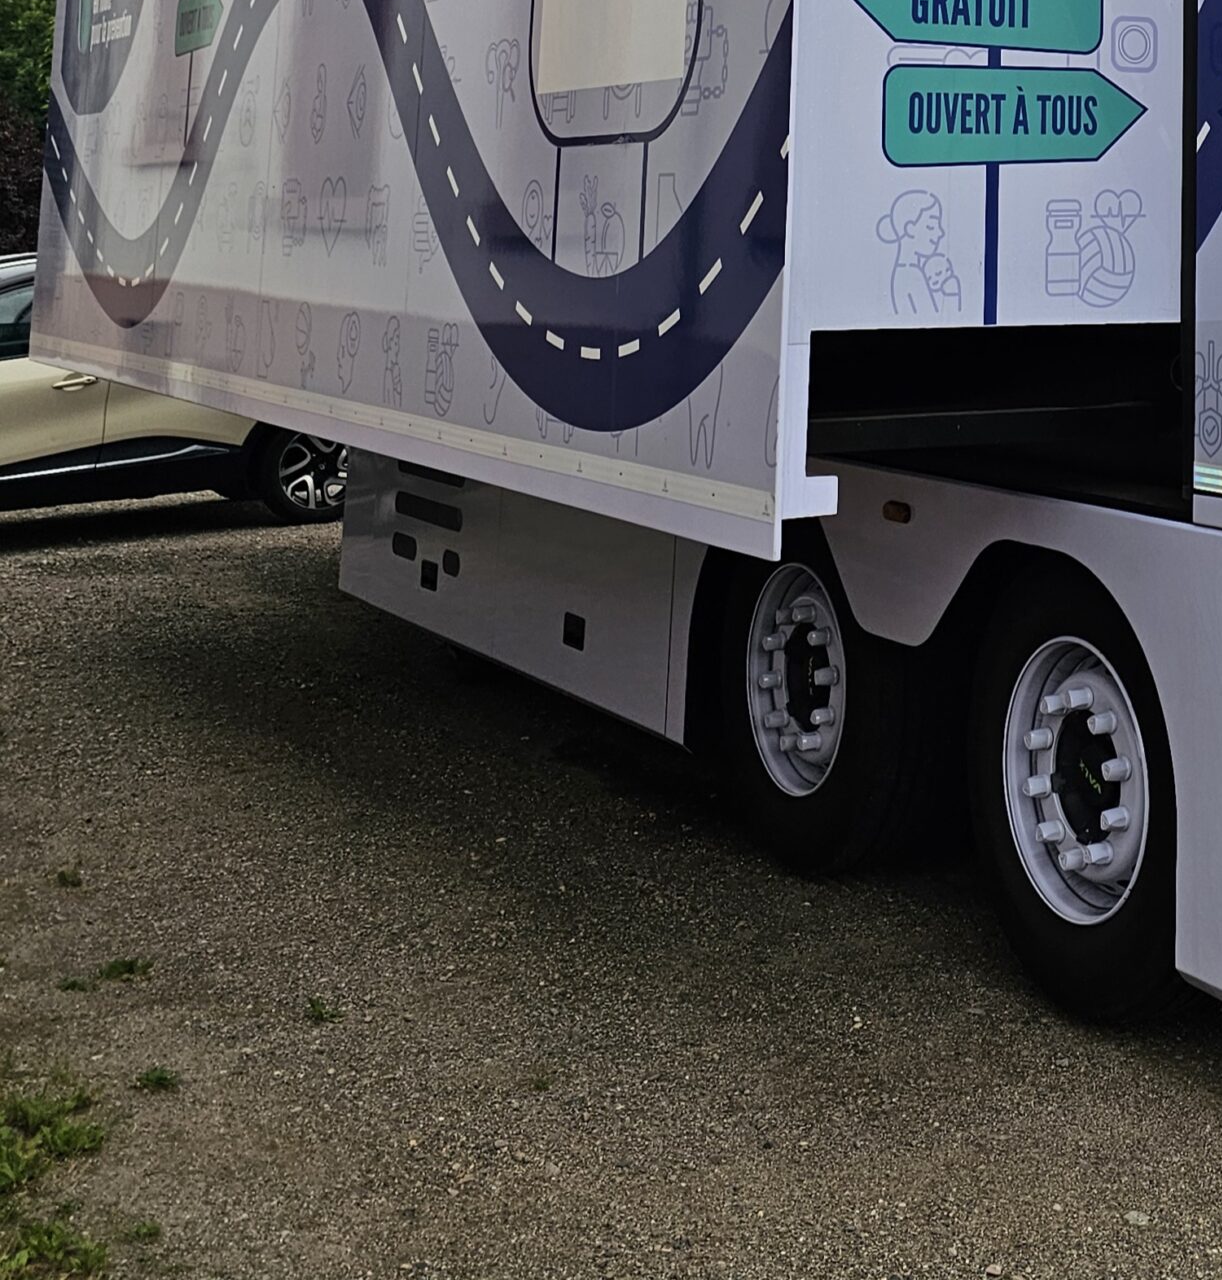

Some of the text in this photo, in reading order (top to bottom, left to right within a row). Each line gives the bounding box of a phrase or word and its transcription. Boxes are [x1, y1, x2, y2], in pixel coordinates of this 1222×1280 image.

[908, 87, 1098, 136] OUVERT À TOUS
